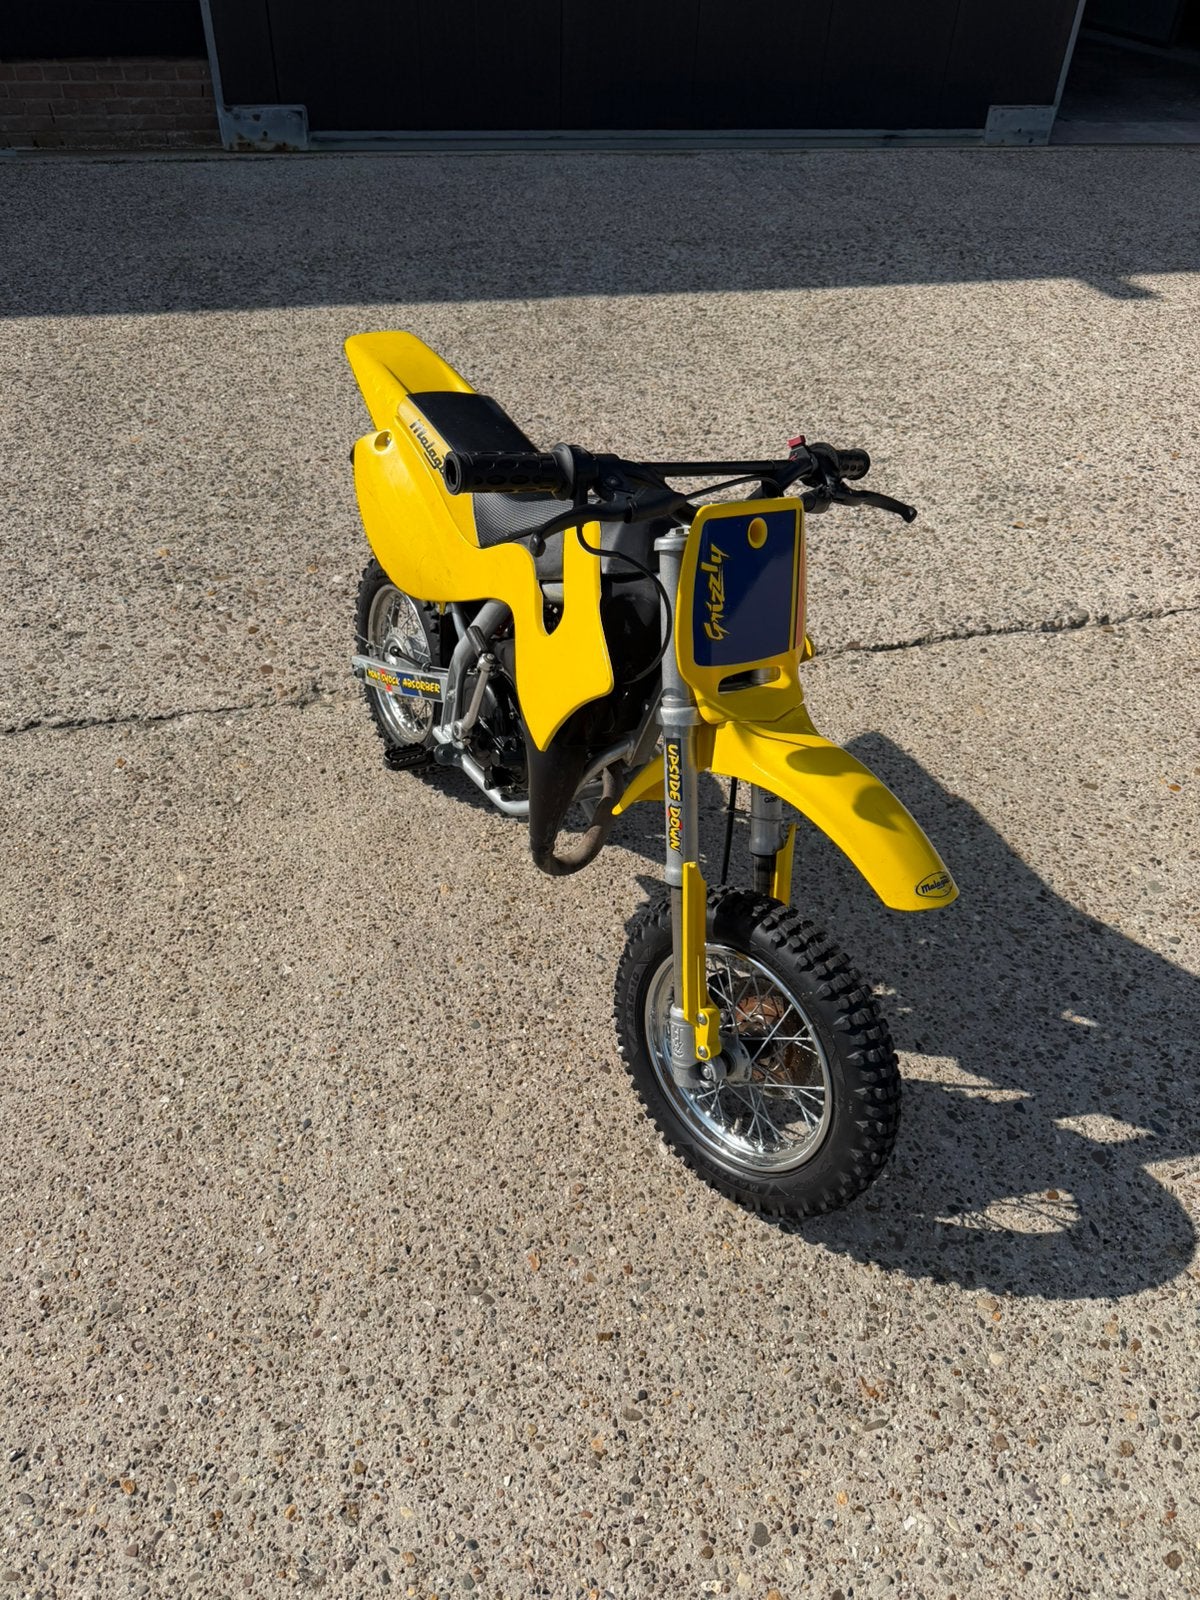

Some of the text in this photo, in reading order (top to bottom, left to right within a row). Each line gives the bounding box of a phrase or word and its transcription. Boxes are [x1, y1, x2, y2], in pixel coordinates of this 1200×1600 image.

[700, 543, 730, 640] Grizzly
[402, 677, 440, 693] ABSORBER
[667, 743, 684, 856] UPSIDE DOWN
